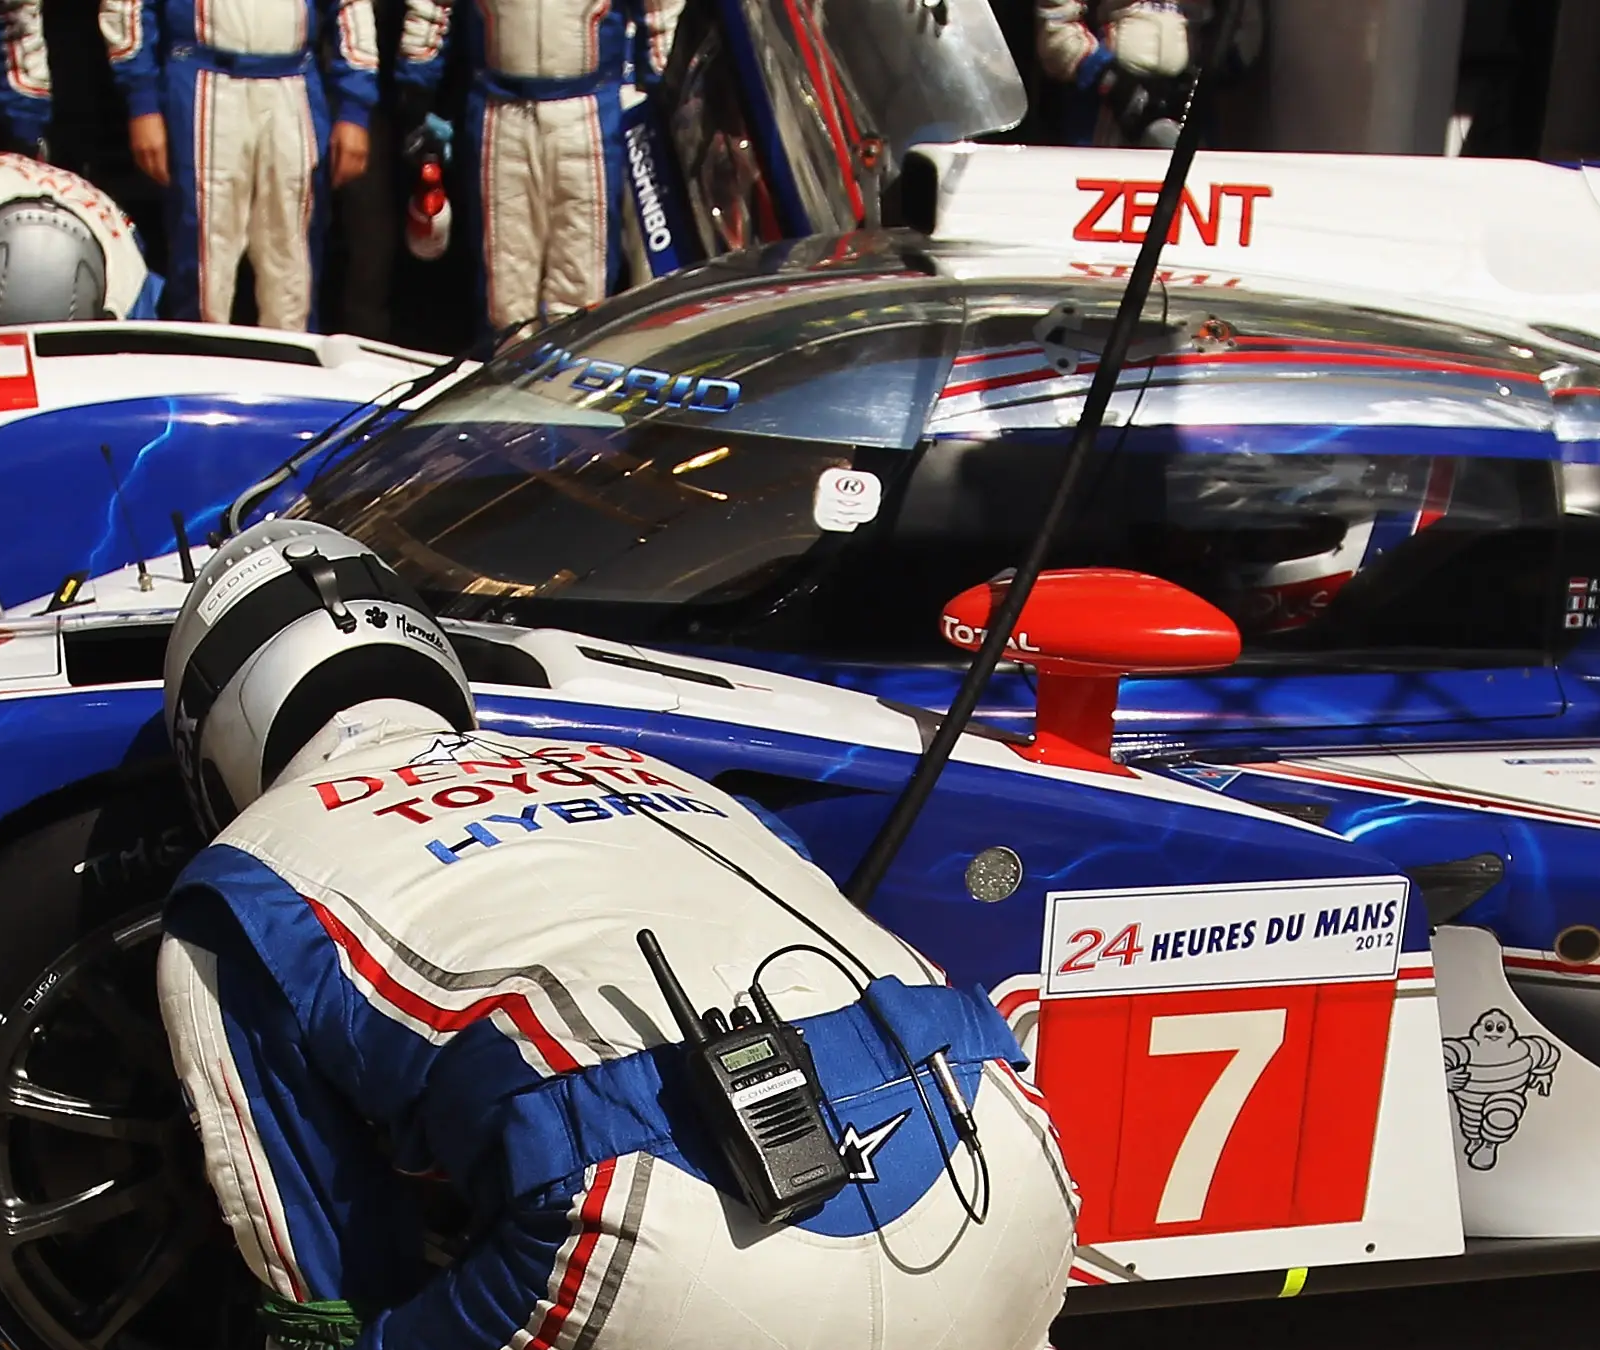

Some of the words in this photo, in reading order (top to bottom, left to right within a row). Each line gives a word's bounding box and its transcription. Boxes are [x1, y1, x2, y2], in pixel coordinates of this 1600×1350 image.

[1073, 180, 1271, 246] ZENT
[519, 342, 741, 413] HYBRID
[206, 556, 274, 611] CEDRIC
[311, 744, 646, 812] DENSO
[374, 766, 694, 825] TOYOTA
[425, 791, 728, 864] HYBRID
[1058, 922, 1144, 976] 24
[1149, 920, 1257, 964] HEURES
[1266, 913, 1308, 948] DU
[1314, 899, 1398, 937] MANS
[1355, 931, 1395, 952] 2012
[1148, 1007, 1288, 1227] 7
